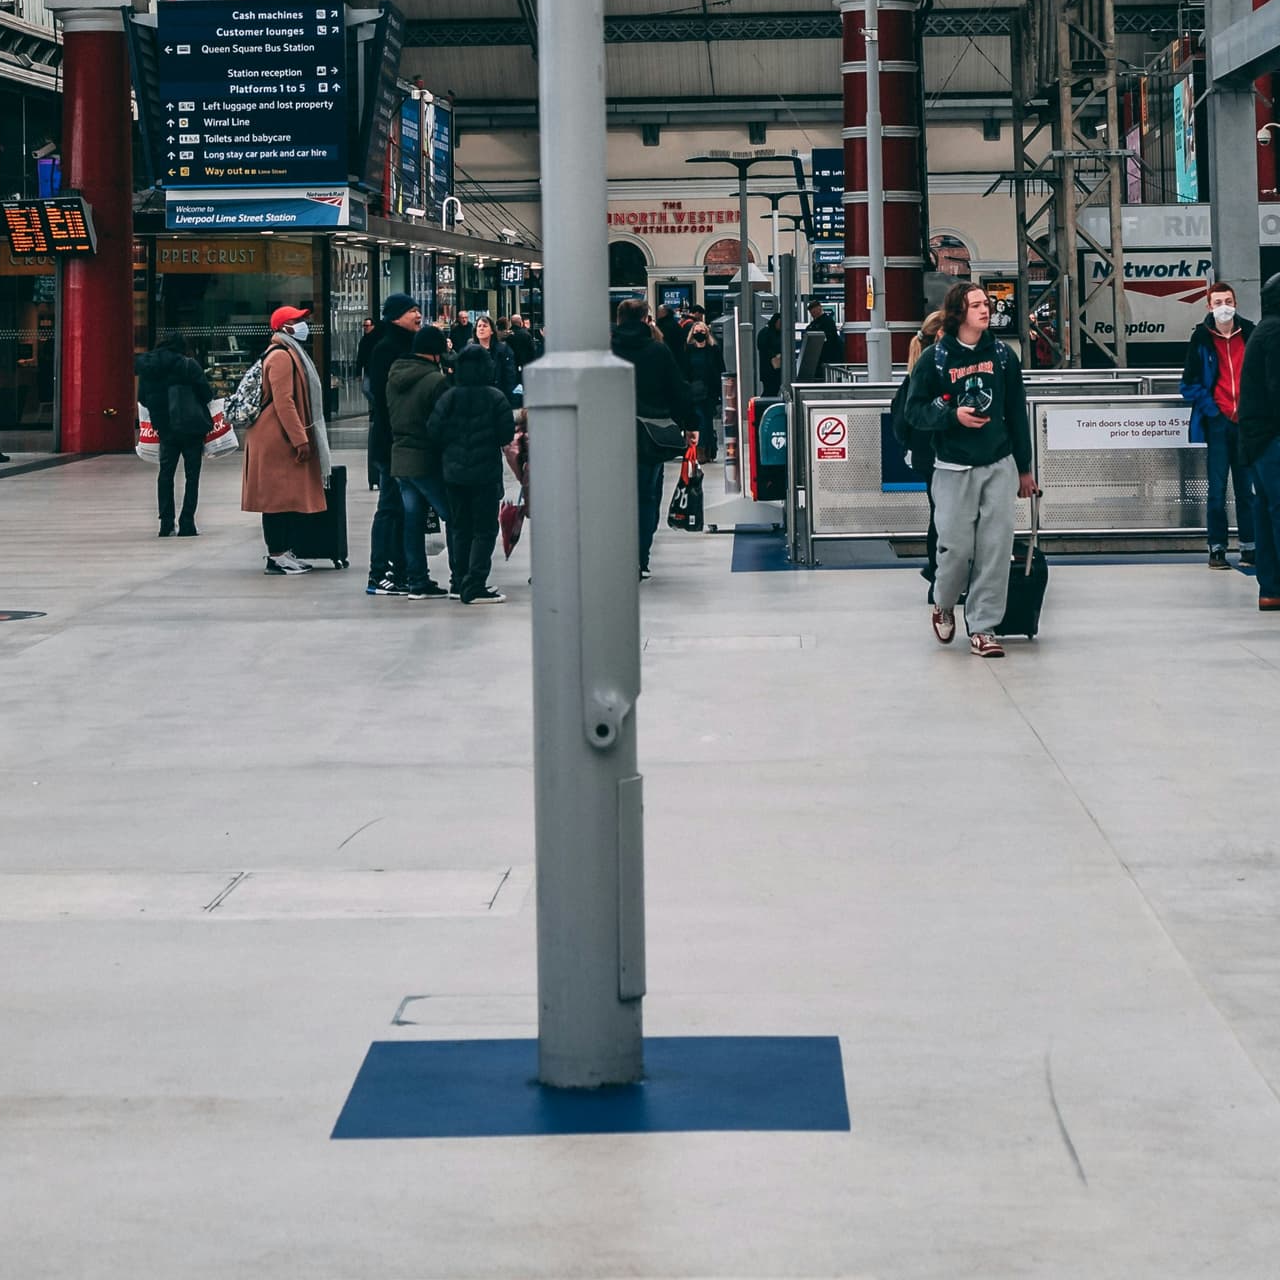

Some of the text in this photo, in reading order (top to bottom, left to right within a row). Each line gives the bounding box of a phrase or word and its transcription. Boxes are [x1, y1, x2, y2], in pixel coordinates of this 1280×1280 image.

[232, 10, 304, 20] Cash machines
[216, 27, 305, 38] Customer lounges
[201, 43, 315, 55] Queen Square Bus Station
[227, 68, 303, 79] Station reception
[229, 83, 306, 94] Platforms 1 to 5
[202, 100, 334, 112] Left luggage and lost property
[203, 117, 250, 127] Wirral Line
[203, 133, 292, 144] Toilets and babycare
[203, 151, 225, 161] Long
[226, 151, 244, 160] stay
[259, 149, 278, 159] park
[279, 148, 295, 158] and
[310, 148, 328, 157] hire
[204, 167, 243, 177] Way out
[175, 213, 297, 225] Liverpool Lime Street Station
[206, 248, 257, 264] CRUST
[1092, 259, 1192, 278] Ntwork
[1077, 420, 1097, 428] Train
[1123, 419, 1144, 427] close
[1146, 420, 1156, 429] up
[1110, 428, 1181, 438] prior to departure
